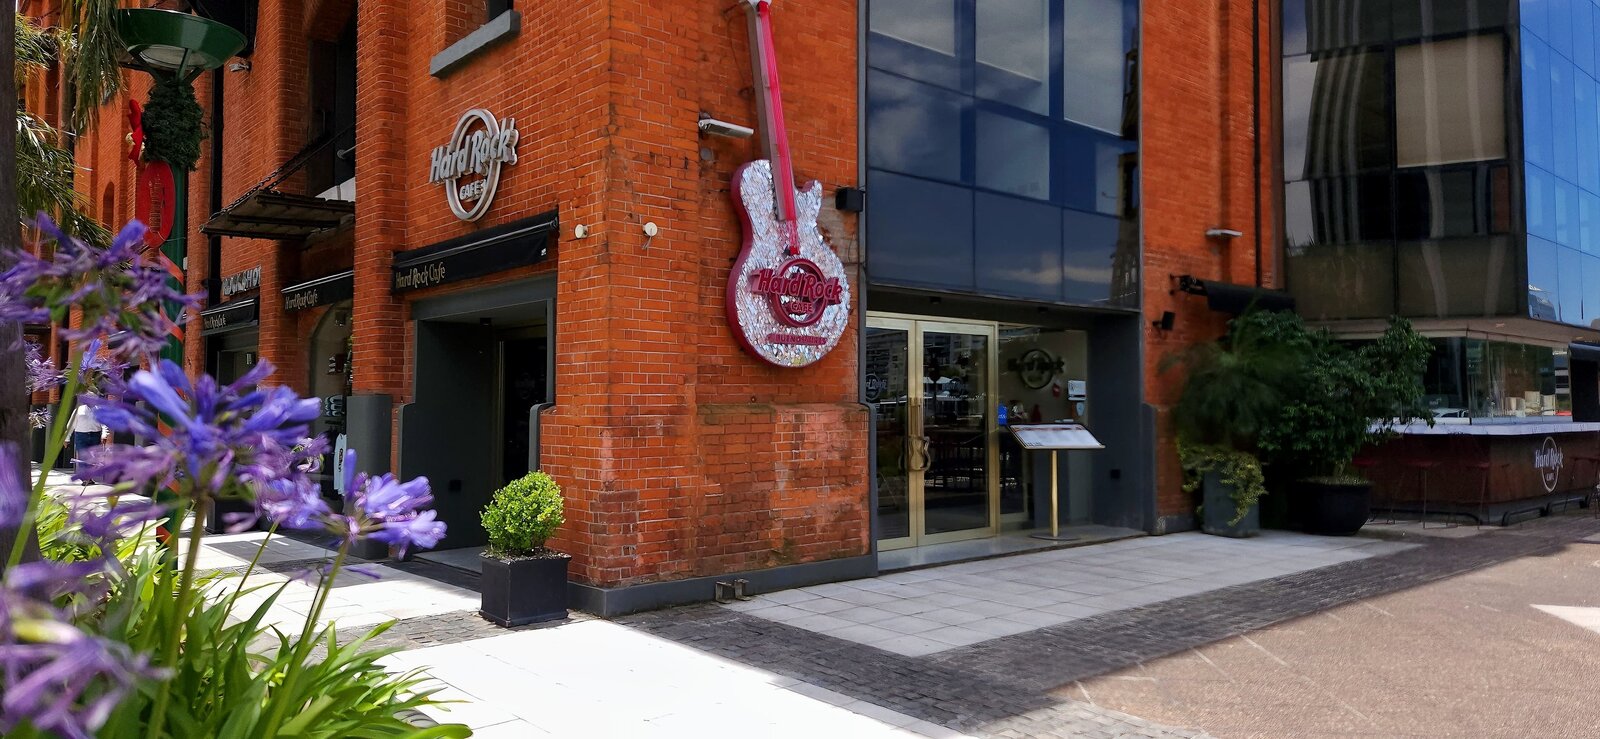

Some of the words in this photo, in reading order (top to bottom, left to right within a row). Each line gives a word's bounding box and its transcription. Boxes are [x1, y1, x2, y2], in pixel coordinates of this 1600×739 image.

[429, 135, 473, 184] Hard
[470, 118, 519, 176] Rock
[460, 179, 487, 201] CAFE
[395, 268, 412, 289] Hard
[412, 265, 429, 289] Rock
[429, 261, 446, 284] Cafe
[757, 268, 803, 297] Hard
[803, 273, 843, 304] Rock
[790, 301, 815, 313] CAFE
[1535, 449, 1550, 469] Hard
[1550, 447, 1564, 470] Rock
